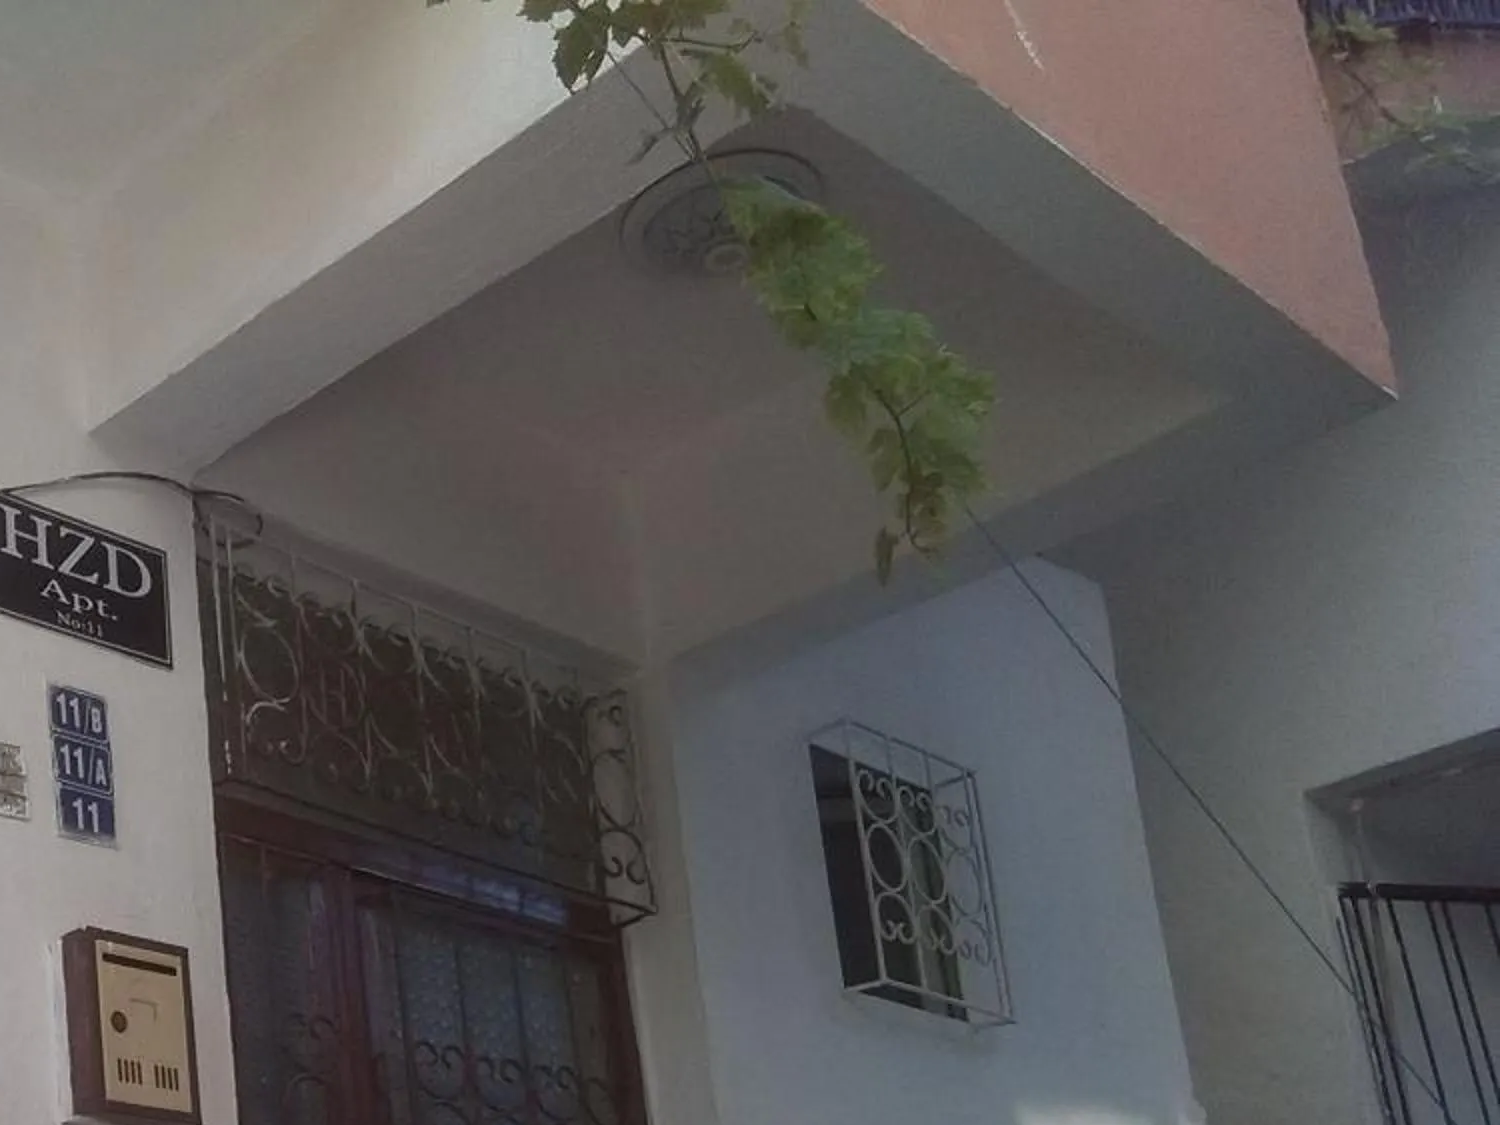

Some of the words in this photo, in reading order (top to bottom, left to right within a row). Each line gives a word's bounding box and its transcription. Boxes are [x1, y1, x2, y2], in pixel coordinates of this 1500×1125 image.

[40, 578, 118, 620] Apt.
[56, 693, 102, 733] 11/B
[60, 744, 107, 787] 11/A
[72, 797, 99, 833] 11
